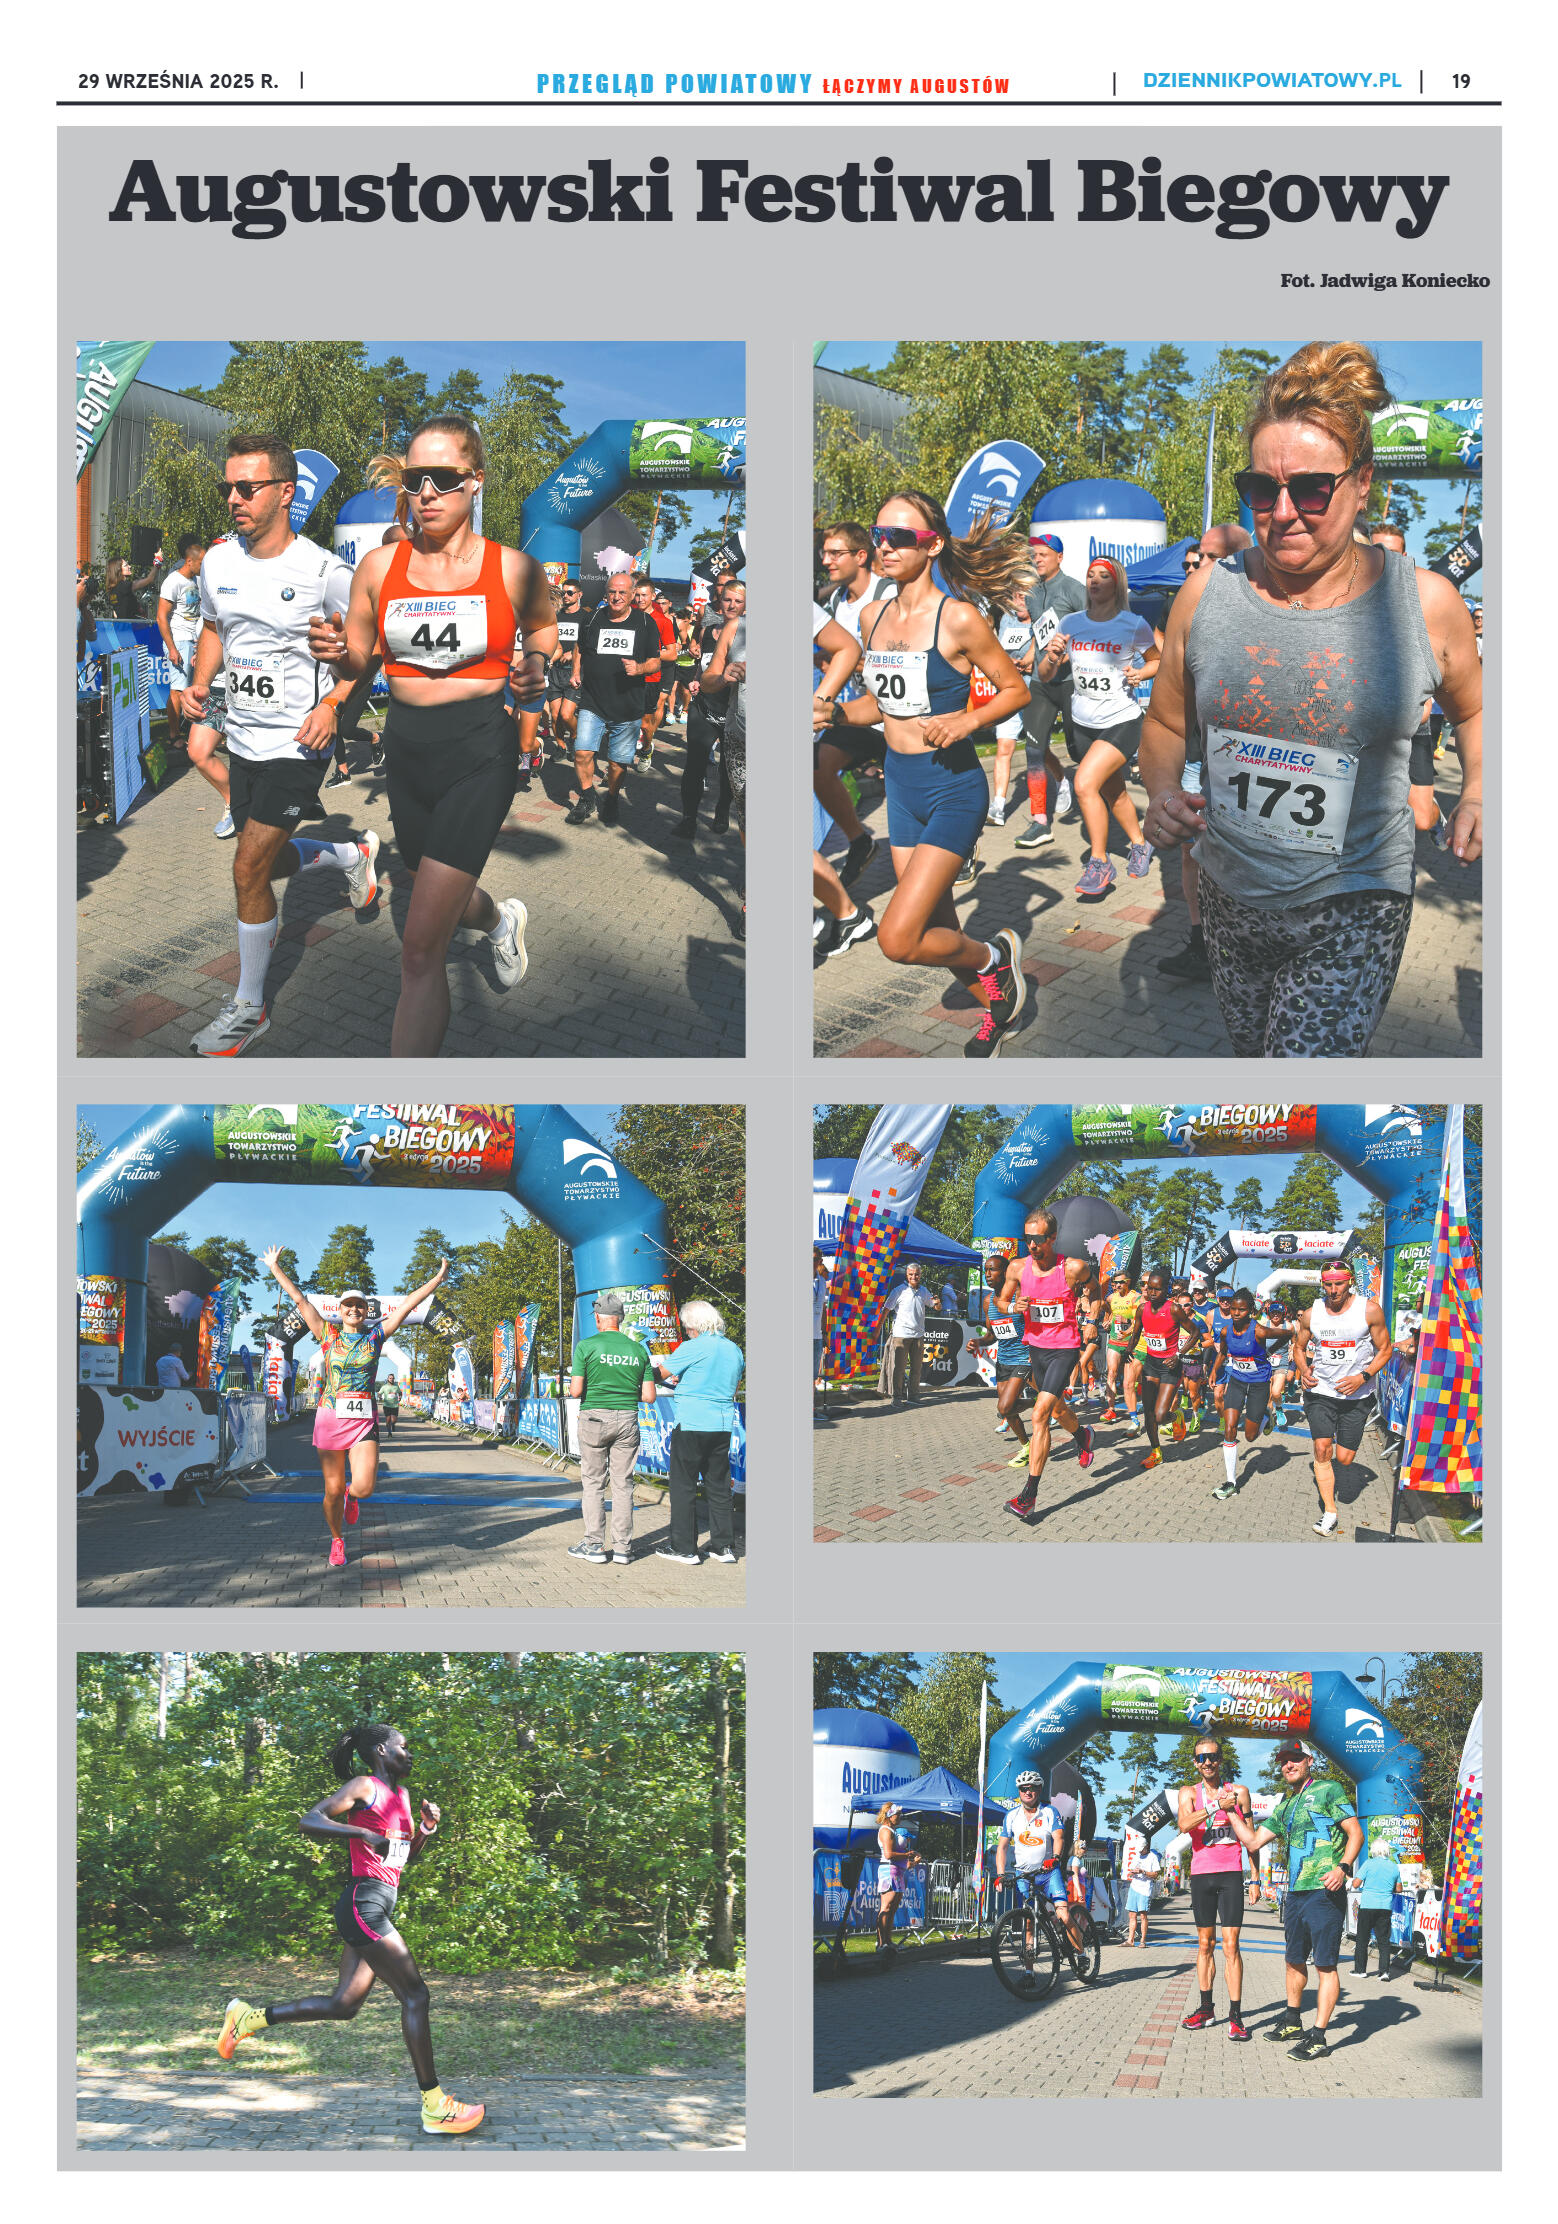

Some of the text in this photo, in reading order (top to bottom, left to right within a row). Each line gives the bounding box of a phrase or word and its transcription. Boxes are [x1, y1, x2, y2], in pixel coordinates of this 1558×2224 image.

[79, 70, 278, 88] 29 WRZEŚNIA 2025 R.
[1144, 73, 1402, 87] DZIENNIKPOWIATOWY.PL
[1453, 74, 1470, 88] 19
[537, 74, 1009, 97] PRZEGLĄD POWIATOWY ŁĄCZYMY AUGUSTÓW
[109, 156, 1450, 239] Augustowski Festiwal Biegowy
[1281, 273, 1490, 291] Fot. Jadwiga Koniecko
[564, 487, 594, 498] Future
[406, 601, 456, 612] XIII BIEG
[1038, 619, 1055, 640] 274
[411, 623, 461, 652] 44
[603, 638, 629, 648] 289
[242, 658, 263, 667] BIEG
[883, 656, 904, 664] BIEG
[229, 671, 275, 698] 346
[875, 673, 906, 699] 20
[1078, 676, 1111, 691] 343
[1237, 741, 1316, 767] XIII BIEG
[1235, 754, 1313, 774] CHARYTATYWNY
[1228, 771, 1327, 827] 173
[1200, 1104, 1294, 1127] BIEGOWY
[1082, 1121, 1132, 1130] AUGUSTOWSKIE
[228, 1132, 296, 1141] AUGUSTOWSKIE
[384, 1125, 492, 1152] BIEGOWY
[1082, 1130, 1133, 1138] TOWARZYSTWO
[1241, 1126, 1288, 1144] 2025
[228, 1142, 297, 1151] TOWARZYSTWO
[229, 1153, 297, 1161] PŁYWACKIE
[1009, 1156, 1038, 1168] Future
[429, 1156, 482, 1174] 2025
[117, 1165, 162, 1180] Future
[1304, 1240, 1335, 1248] łaciate
[1036, 1307, 1057, 1317] 107
[92, 1319, 117, 1329] 2025
[995, 1325, 1011, 1334] 104
[1148, 1338, 1162, 1347] 103
[600, 1353, 639, 1366] SĘDZIA
[1330, 1349, 1346, 1360] 39
[932, 1359, 952, 1371] lat
[346, 1401, 363, 1412] 44
[118, 1426, 195, 1447] WYJŚCIE
[1173, 1668, 1289, 1680] AUGUSTOWSKI
[1198, 1679, 1273, 1700] FESTIWAL
[1111, 1707, 1159, 1715] TOWARZYSTWO
[1219, 1697, 1295, 1718] BIEGOWY
[1035, 1722, 1065, 1733] Future
[1252, 1719, 1289, 1731] 2025
[1211, 1827, 1231, 1839] 107
